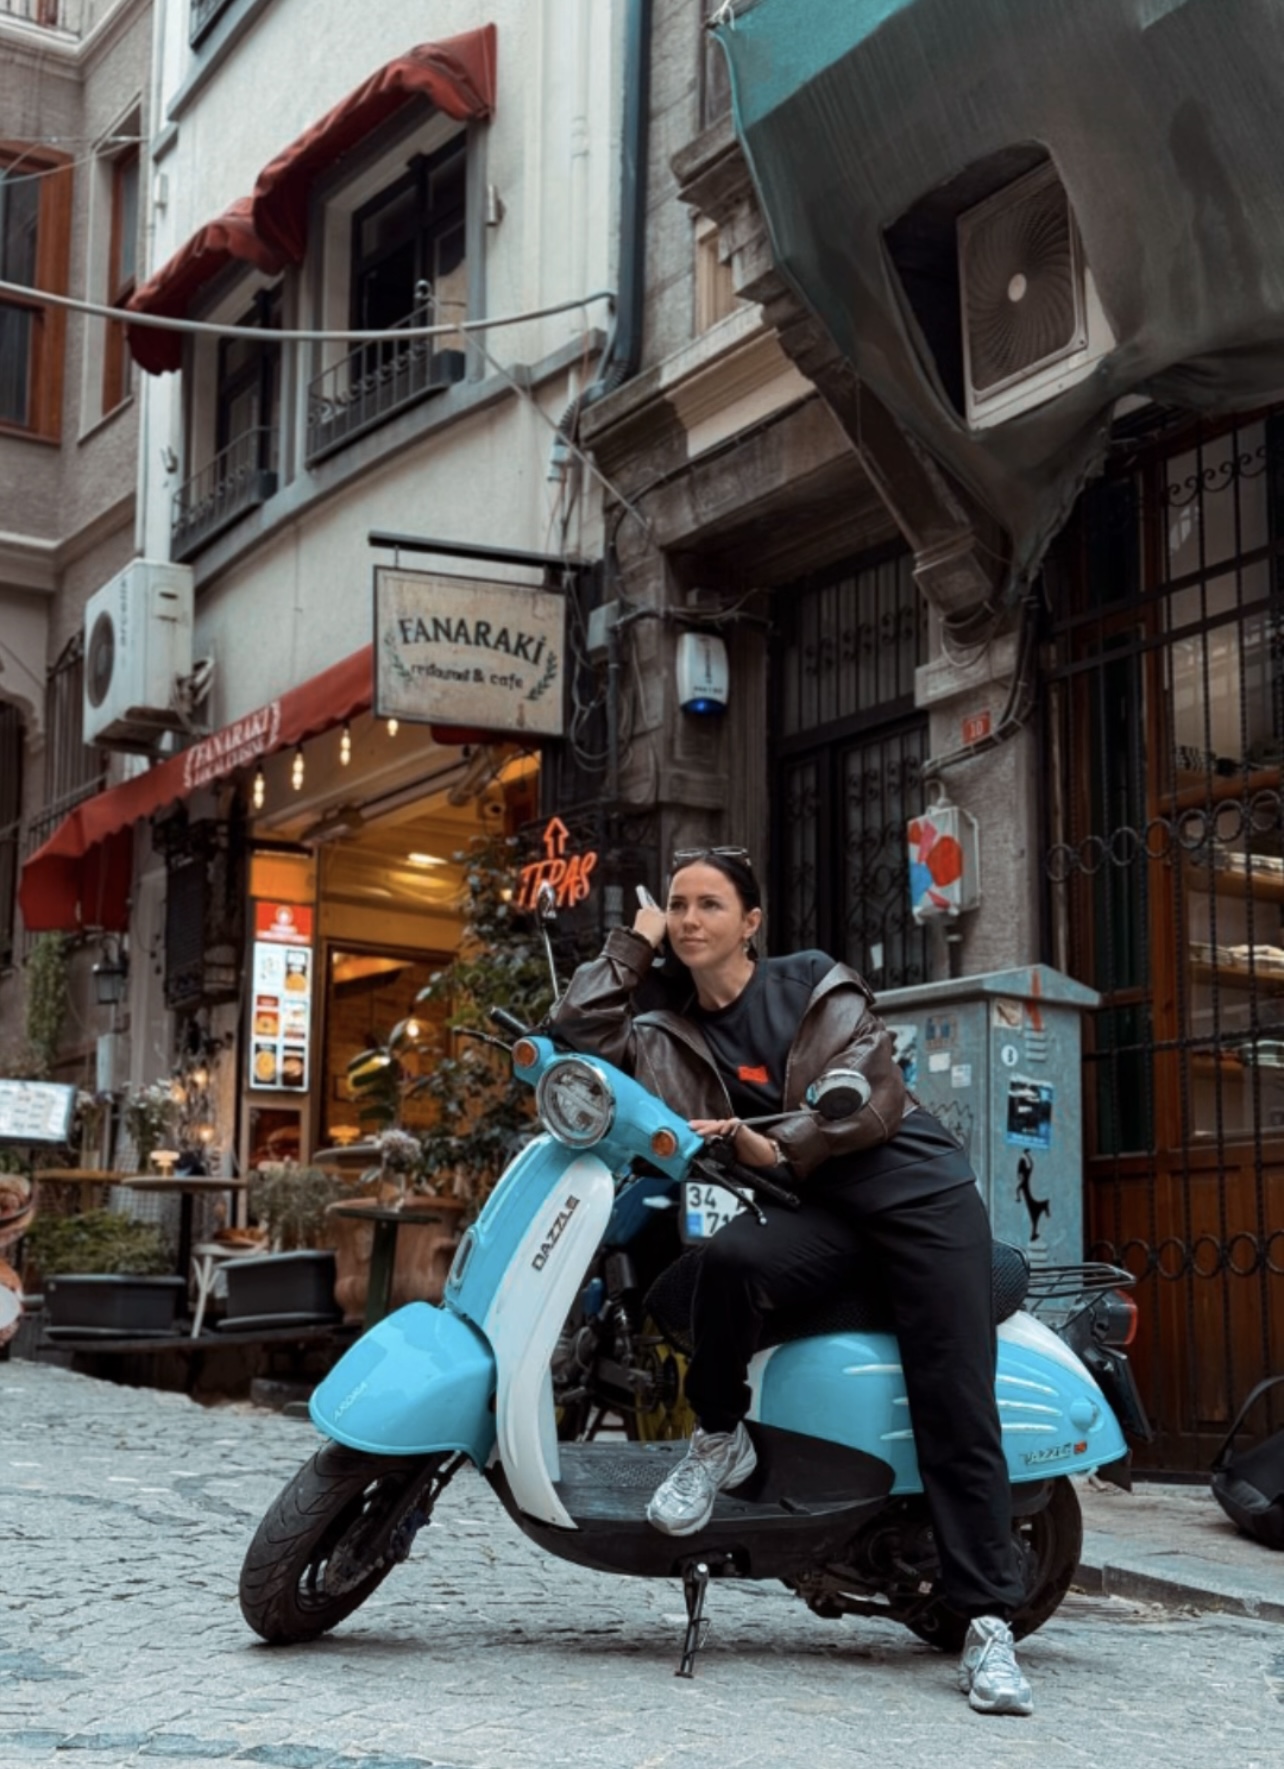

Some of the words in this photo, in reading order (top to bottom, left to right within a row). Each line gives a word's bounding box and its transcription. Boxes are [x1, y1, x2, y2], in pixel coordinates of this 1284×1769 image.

[473, 668, 485, 684] &
[490, 673, 524, 691] cafe
[689, 1185, 717, 1209] 34
[531, 1195, 581, 1272] DAZZLE
